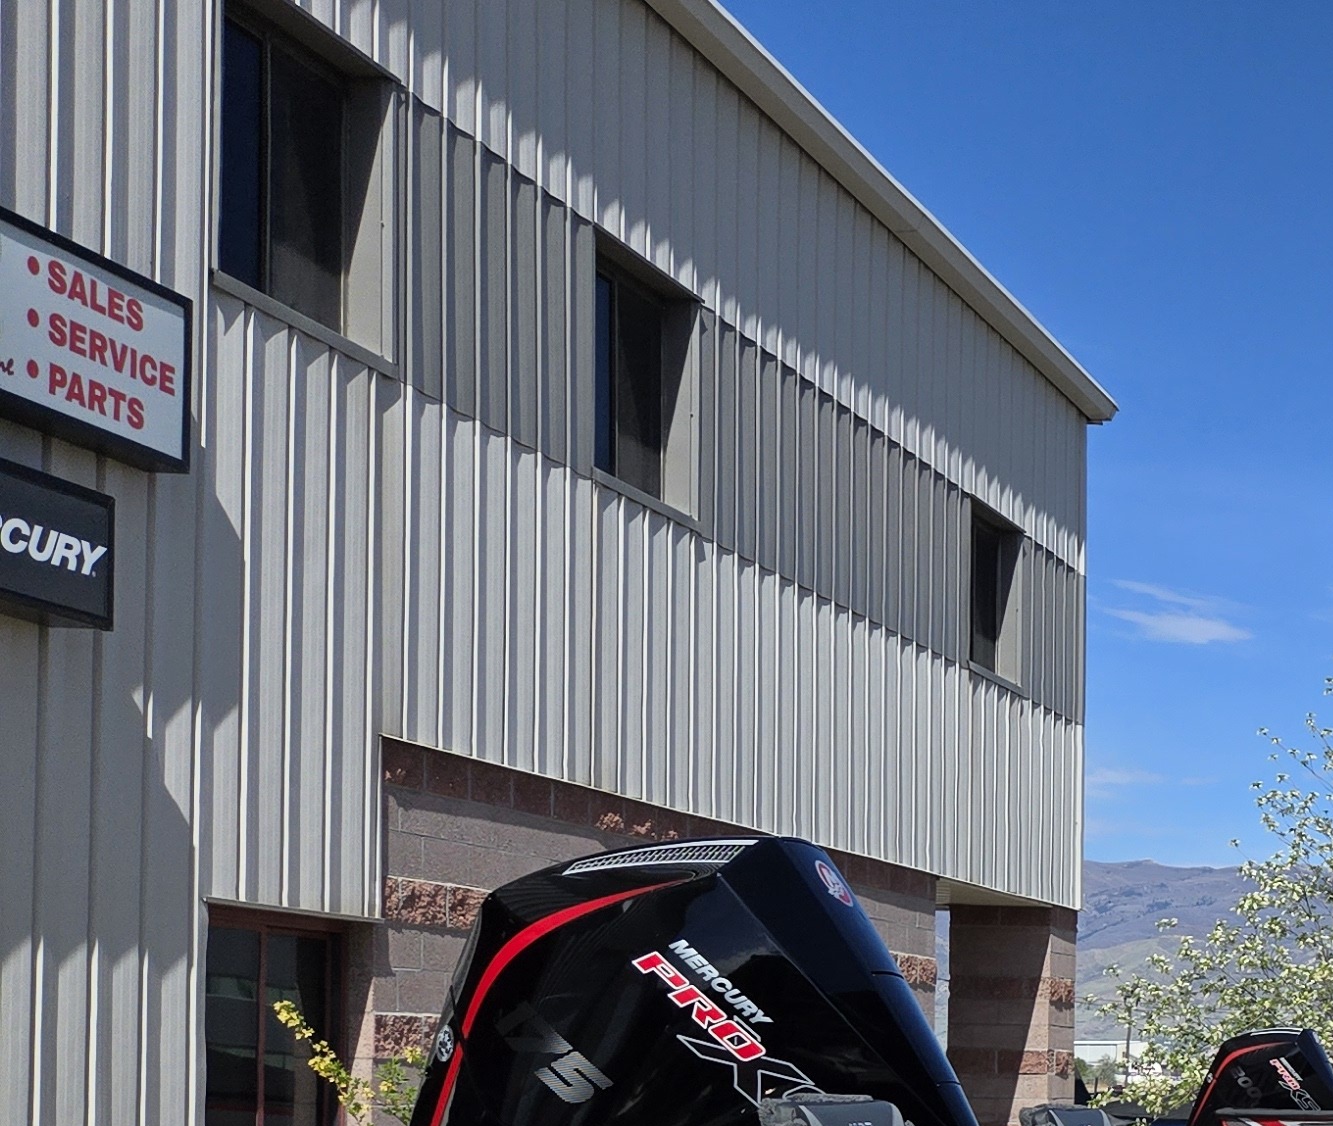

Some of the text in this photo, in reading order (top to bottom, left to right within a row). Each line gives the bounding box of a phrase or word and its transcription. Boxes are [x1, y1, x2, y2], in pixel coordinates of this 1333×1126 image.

[48, 259, 144, 332] SALES
[48, 312, 176, 396] SERVICE
[48, 361, 145, 430] PARTS
[0, 517, 107, 576] CURY
[631, 950, 767, 1062] PRO
[668, 938, 774, 1024] MERCURY
[675, 1015, 827, 1109] X
